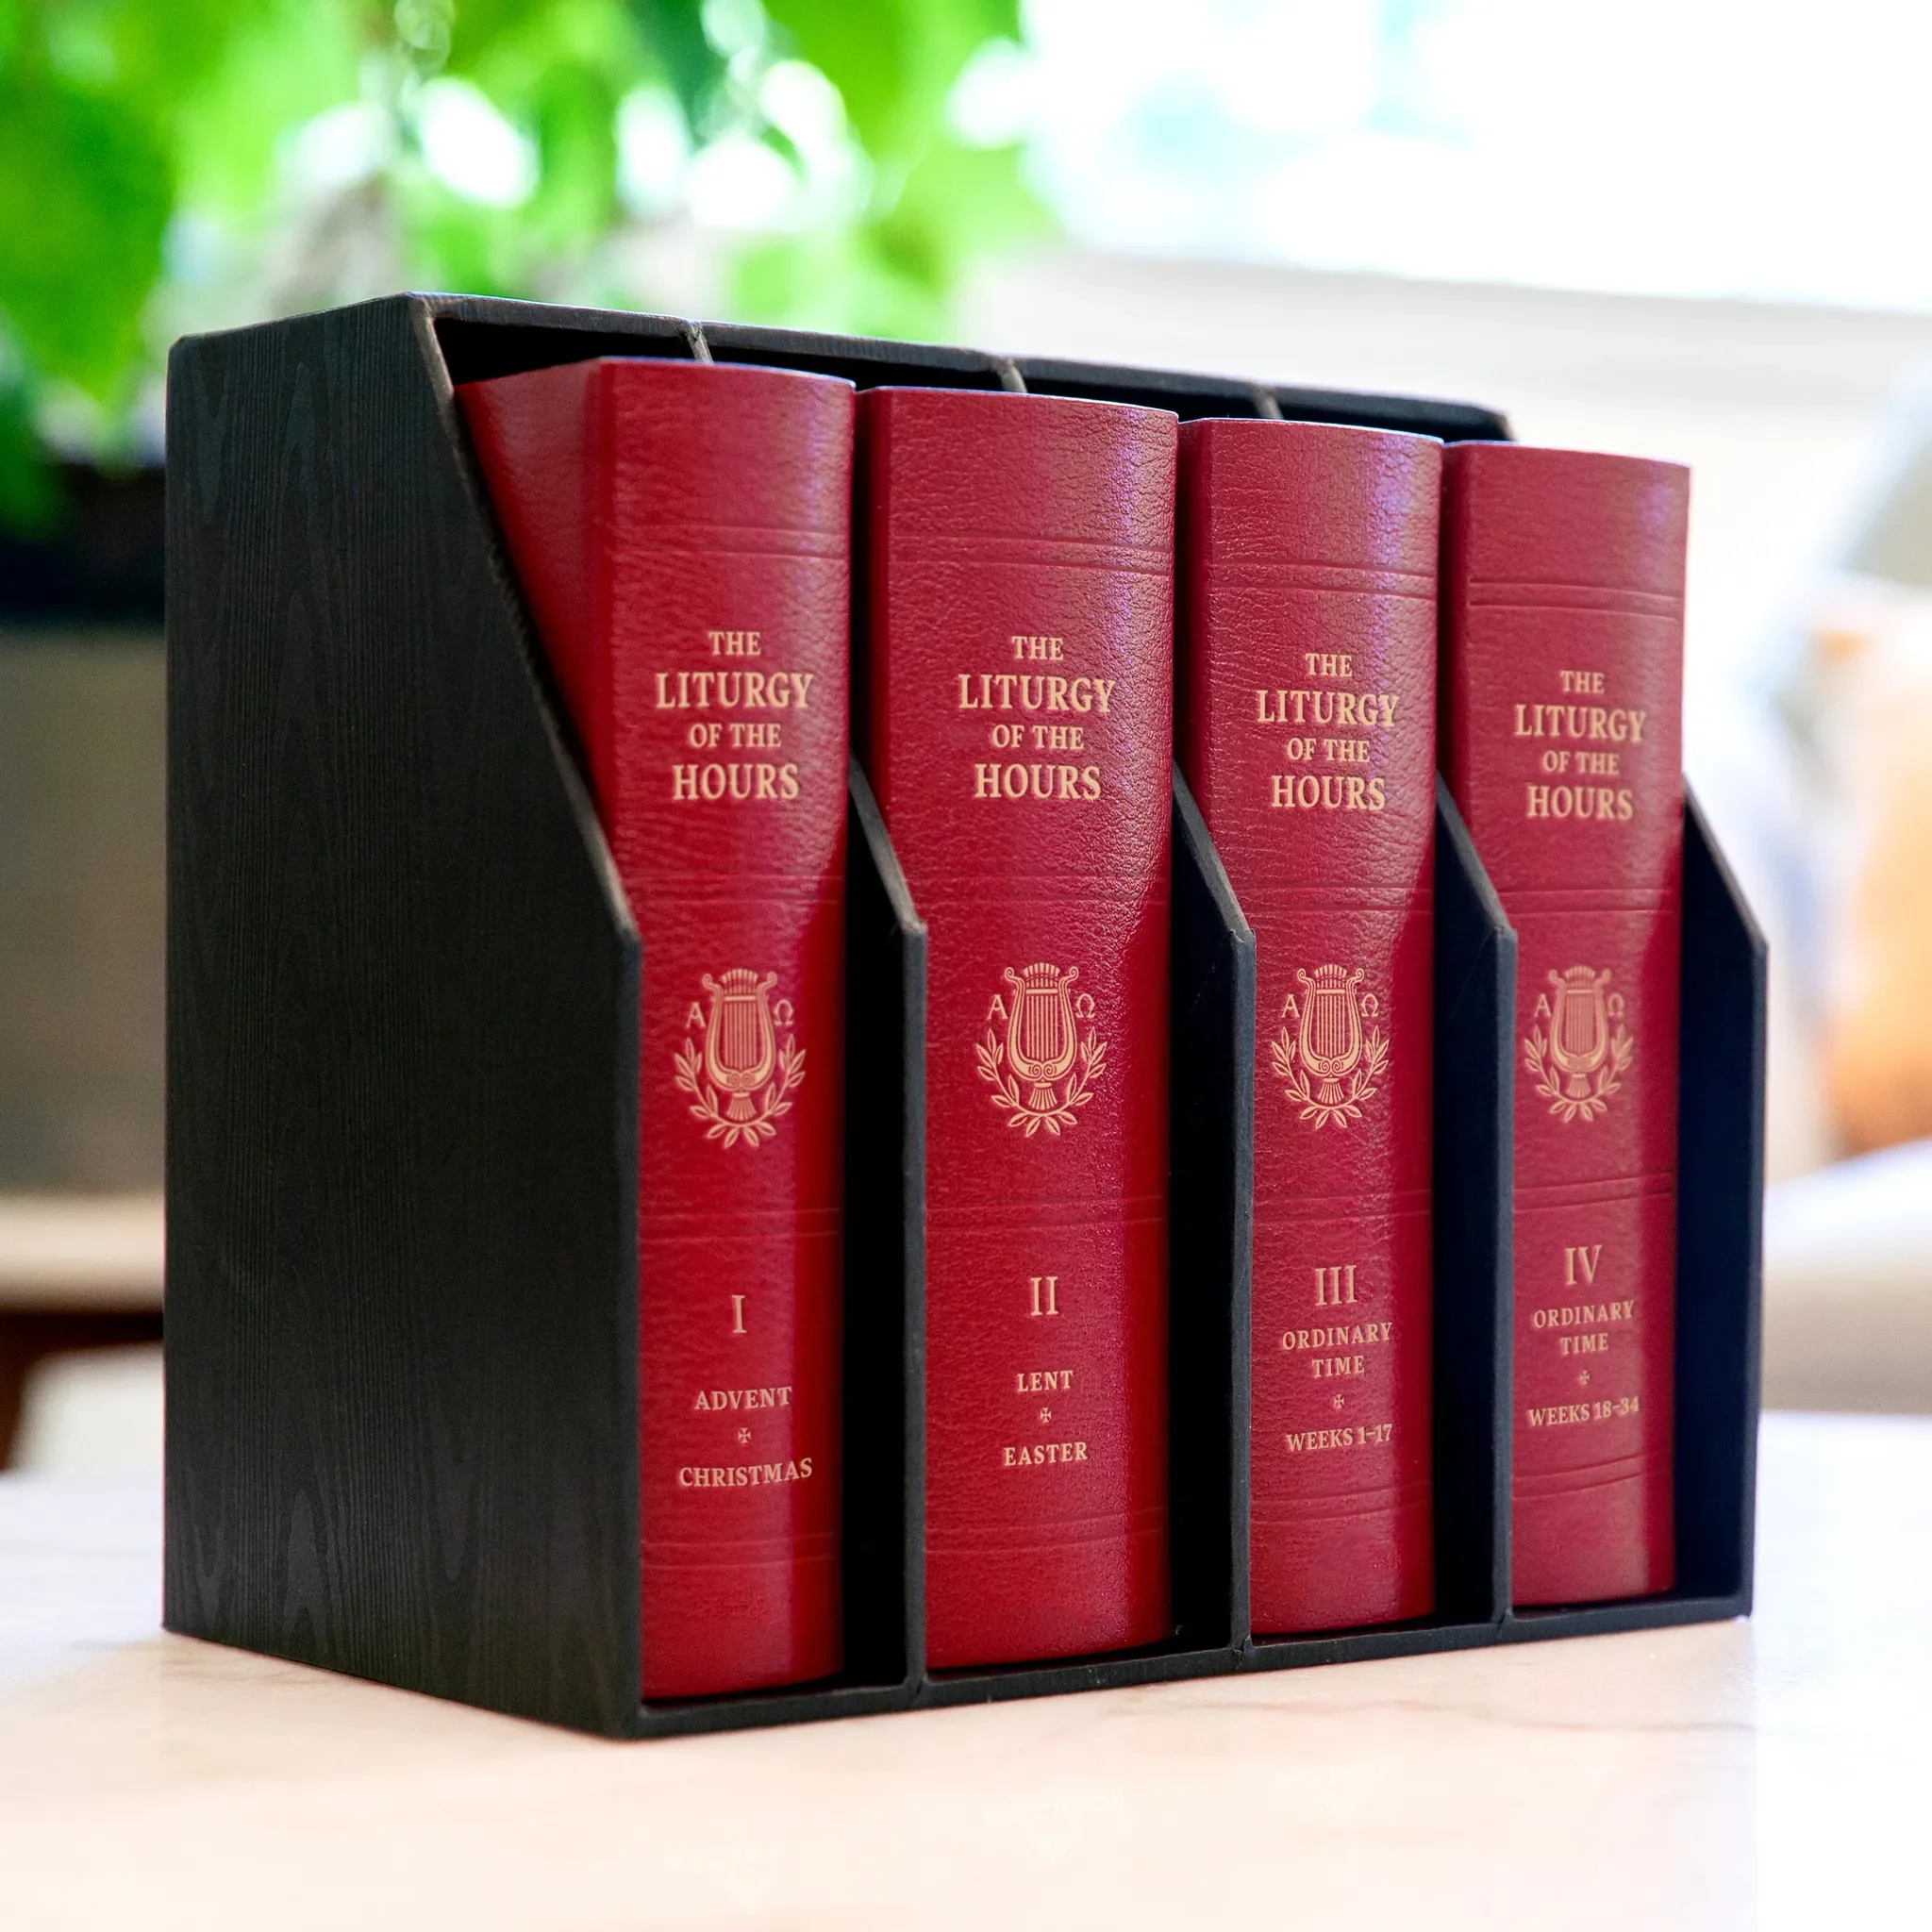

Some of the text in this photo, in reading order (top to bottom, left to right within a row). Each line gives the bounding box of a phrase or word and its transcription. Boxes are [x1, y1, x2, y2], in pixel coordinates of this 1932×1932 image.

[708, 630, 761, 657] THE
[1010, 635, 1065, 663] THE
[1304, 652, 1353, 679] THE
[656, 671, 814, 710] LITURGY
[958, 673, 1117, 713] LITURGY
[1559, 670, 1606, 695] THE
[1256, 689, 1401, 729] LITURGY
[1514, 703, 1647, 743] LITURGY
[688, 723, 782, 749] OF THE
[991, 724, 1085, 751] OF THE
[1284, 737, 1372, 765] OF THE
[1541, 750, 1620, 776] OF THE
[672, 762, 800, 801] HOURS
[974, 763, 1102, 804] HOURS
[1271, 774, 1386, 811] HOURS
[1525, 784, 1635, 821] HOURS
[1565, 1244, 1603, 1286] IV
[1029, 1275, 1059, 1317] II
[1314, 1264, 1358, 1307] III
[731, 1294, 747, 1334] I
[1533, 1299, 1635, 1330] ORDINARY
[1281, 1322, 1393, 1351] ORDINARY
[1559, 1332, 1609, 1356] TIME
[1017, 1369, 1074, 1392] LENT
[1311, 1355, 1365, 1379] TIME
[693, 1386, 792, 1411] ADVENT
[1527, 1403, 1591, 1427] WEEKS
[1003, 1441, 1089, 1467] EASTER
[1285, 1427, 1354, 1453] WEEKS
[678, 1457, 812, 1488] CHRISTMAS
